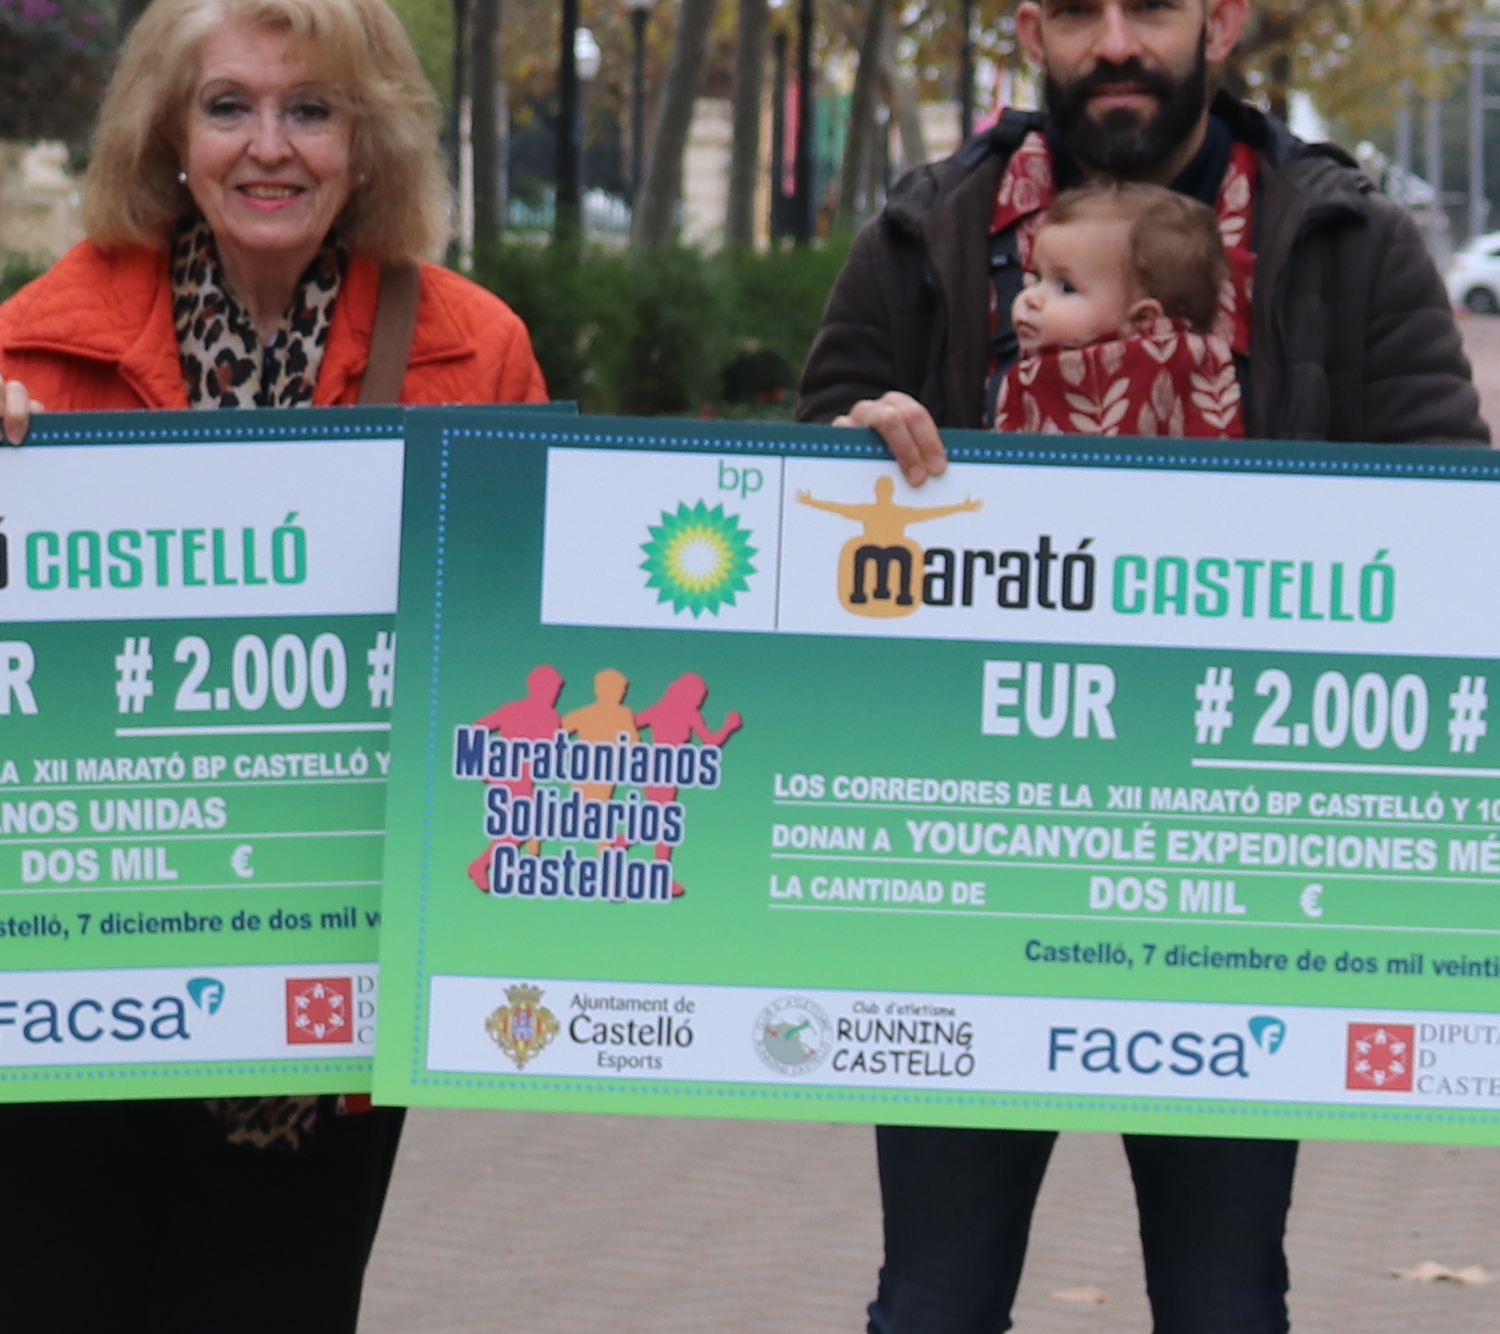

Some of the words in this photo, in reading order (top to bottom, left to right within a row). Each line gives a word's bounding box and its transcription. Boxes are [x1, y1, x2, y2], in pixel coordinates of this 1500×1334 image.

[717, 460, 764, 499] bp
[25, 511, 307, 590] CASTELLÓ
[850, 534, 1095, 611] marató
[1112, 549, 1395, 624] CASTELLÓ
[114, 636, 154, 714] #
[174, 632, 347, 711] 2.000
[981, 660, 1117, 740] EUR
[1194, 666, 1234, 744] #
[1252, 669, 1428, 751] 2.000
[1449, 675, 1487, 754] #
[33, 759, 68, 783] XII
[76, 751, 185, 782] MARATÓ
[193, 755, 227, 779] BP
[234, 748, 368, 777] CASTELLÓ
[454, 728, 721, 787] Maratonianos
[89, 797, 227, 832] UNIDAS
[486, 787, 683, 843] Solidarios
[774, 773, 825, 798] LOS
[832, 776, 1011, 805] CORREDORES
[1017, 781, 1053, 806] DE
[1059, 784, 1093, 808] LA
[1107, 785, 1142, 810] XII
[1150, 785, 1260, 814] MARATÓ
[1267, 791, 1302, 815] BP
[1308, 792, 1444, 820] CASTELLÓ
[1451, 798, 1471, 821] Y
[22, 848, 100, 883] DOS
[111, 847, 178, 881] MIL
[230, 844, 254, 879] €
[772, 824, 866, 851] DONAN
[872, 828, 891, 851] A
[906, 820, 1156, 861] YOUCANYOLÉ
[1167, 829, 1438, 871] EXPEDICIONES
[492, 846, 670, 901] Castellon
[770, 875, 803, 898] LA
[810, 876, 943, 903] CANTIDAD
[952, 881, 986, 905] DE
[1089, 876, 1168, 911] DOS
[1179, 879, 1246, 915] MIL
[1300, 883, 1324, 917] €
[77, 914, 91, 935] 7
[101, 911, 223, 934] diciembre
[231, 910, 260, 931] de
[269, 908, 312, 930] dos
[321, 906, 357, 929] mil
[1025, 939, 1134, 969] Castelló,
[1142, 945, 1157, 965] 7
[1164, 945, 1288, 971] diciembre
[1297, 949, 1325, 972] de
[1335, 951, 1378, 974] dos
[1387, 953, 1423, 975] mil
[569, 993, 670, 1016] Ajuntament
[674, 996, 695, 1013] de
[569, 1014, 694, 1047] Castelló
[836, 1017, 974, 1046] RUNNING
[597, 1051, 663, 1072] Esports
[832, 1043, 976, 1077] CASTELLÓ
[1048, 1025, 1249, 1078] Facsa
